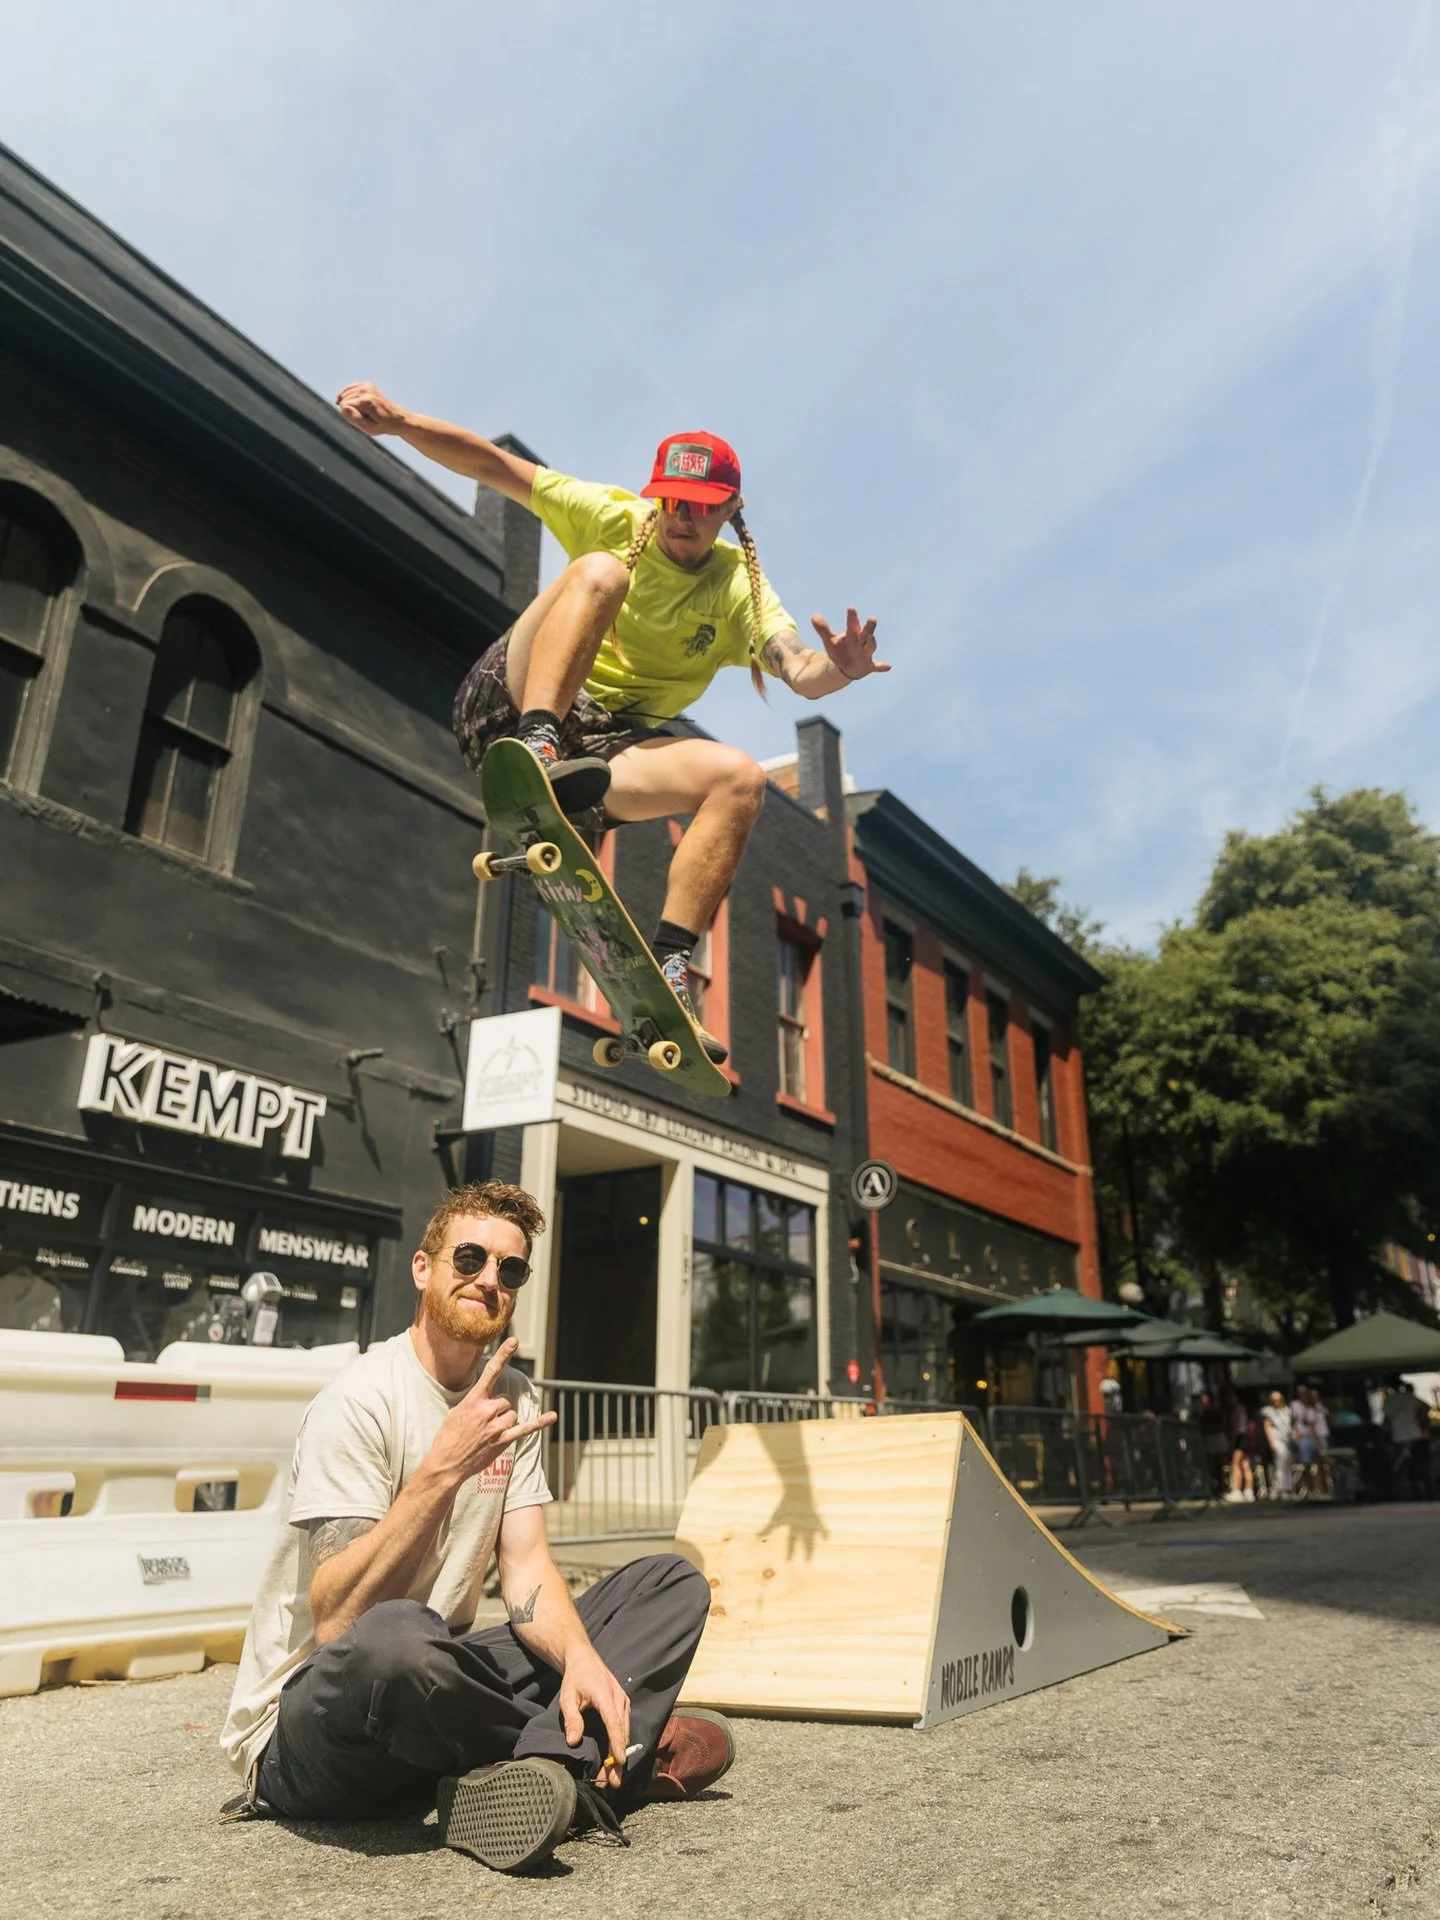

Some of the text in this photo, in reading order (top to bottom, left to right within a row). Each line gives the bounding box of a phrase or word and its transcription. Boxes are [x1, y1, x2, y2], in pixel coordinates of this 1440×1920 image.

[681, 462, 705, 475] MAN
[77, 1033, 327, 1159] KEMPT
[573, 1082, 630, 1119] STUDIO
[133, 1205, 236, 1246] MODERN
[259, 1228, 369, 1268] MENSWEAR
[940, 1644, 1015, 1710] MOBILE RAMPS
